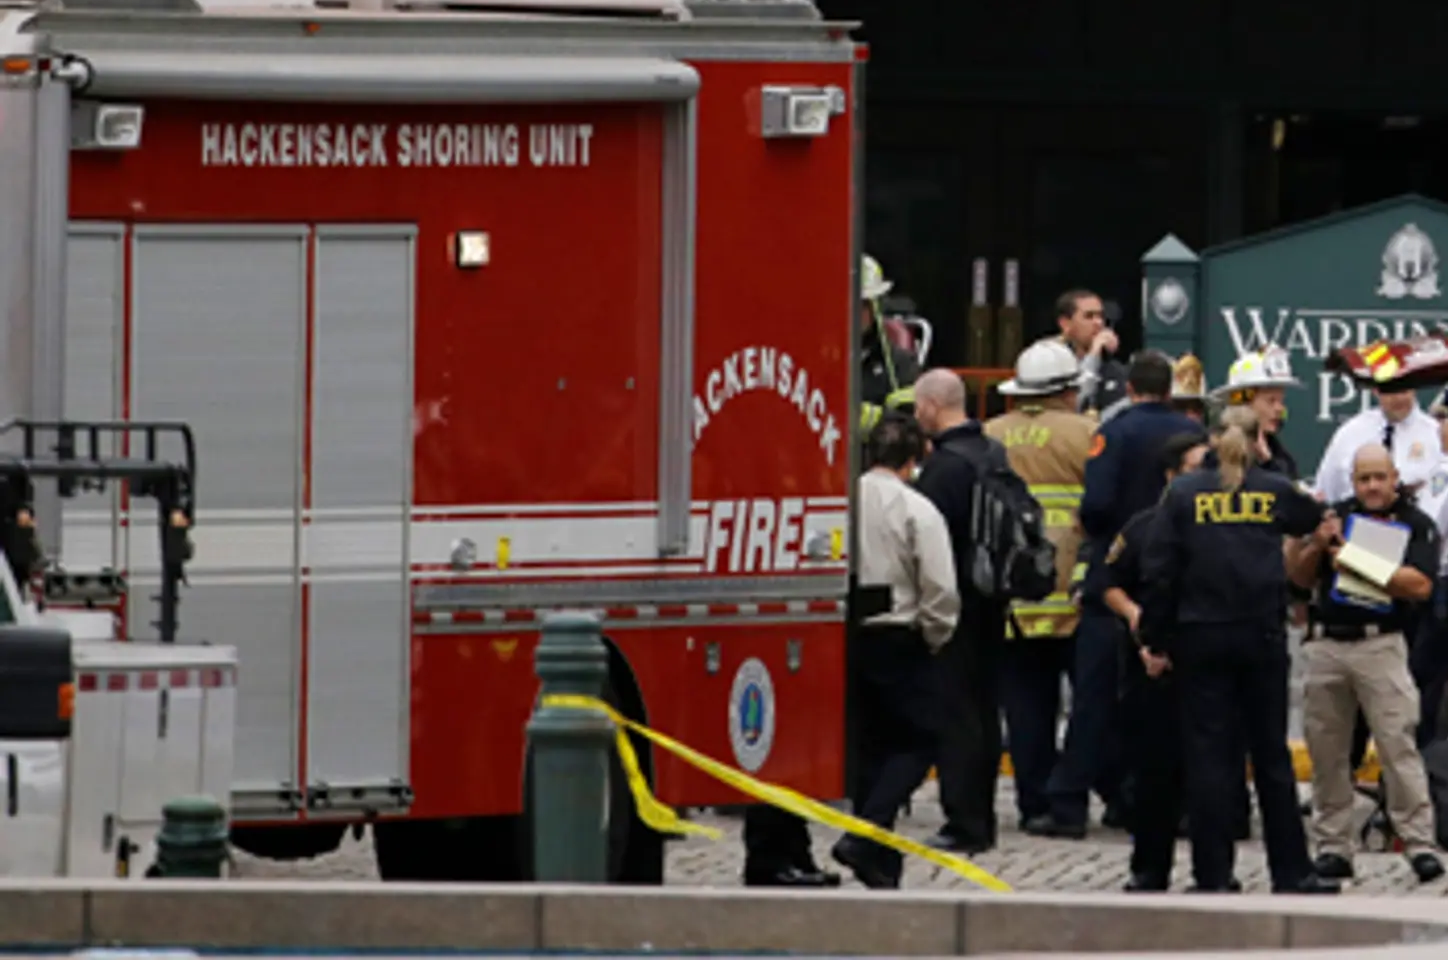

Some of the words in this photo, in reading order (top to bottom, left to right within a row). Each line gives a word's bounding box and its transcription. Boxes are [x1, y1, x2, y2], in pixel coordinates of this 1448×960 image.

[201, 123, 389, 167] HACKENSACK
[397, 123, 520, 167] SHORING
[528, 123, 595, 167] UNIT
[690, 346, 842, 466] ACKENSACK
[706, 497, 806, 573] FIRE
[1194, 491, 1277, 524] POLICE
